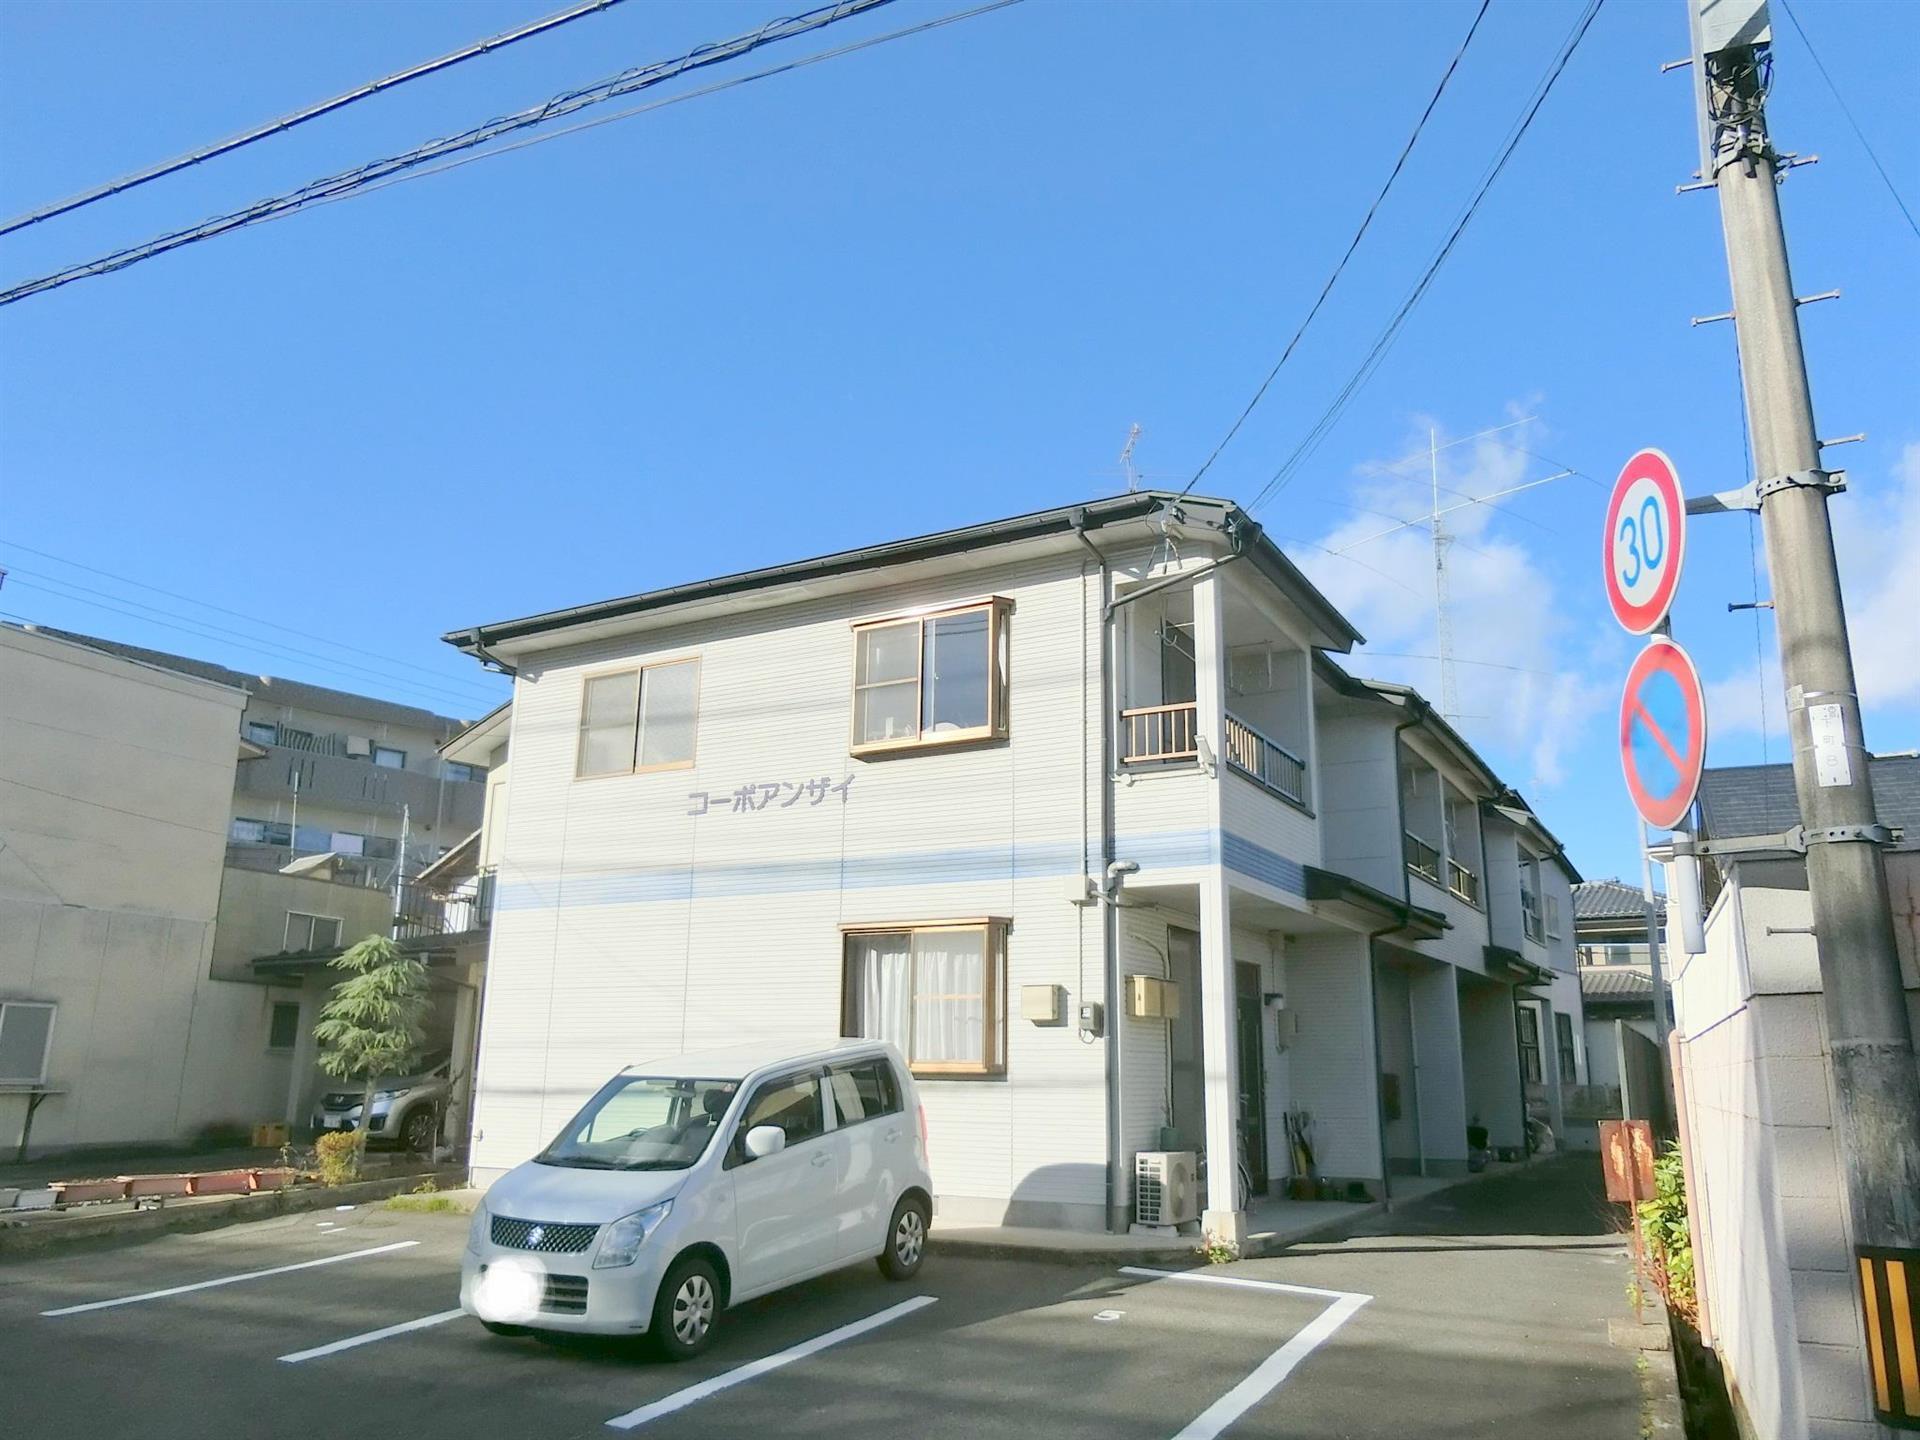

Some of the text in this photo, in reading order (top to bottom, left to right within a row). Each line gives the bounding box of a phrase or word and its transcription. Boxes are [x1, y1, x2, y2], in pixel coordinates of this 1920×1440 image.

[1619, 495, 1663, 588] 30
[687, 773, 856, 816] コーポアンザイ
